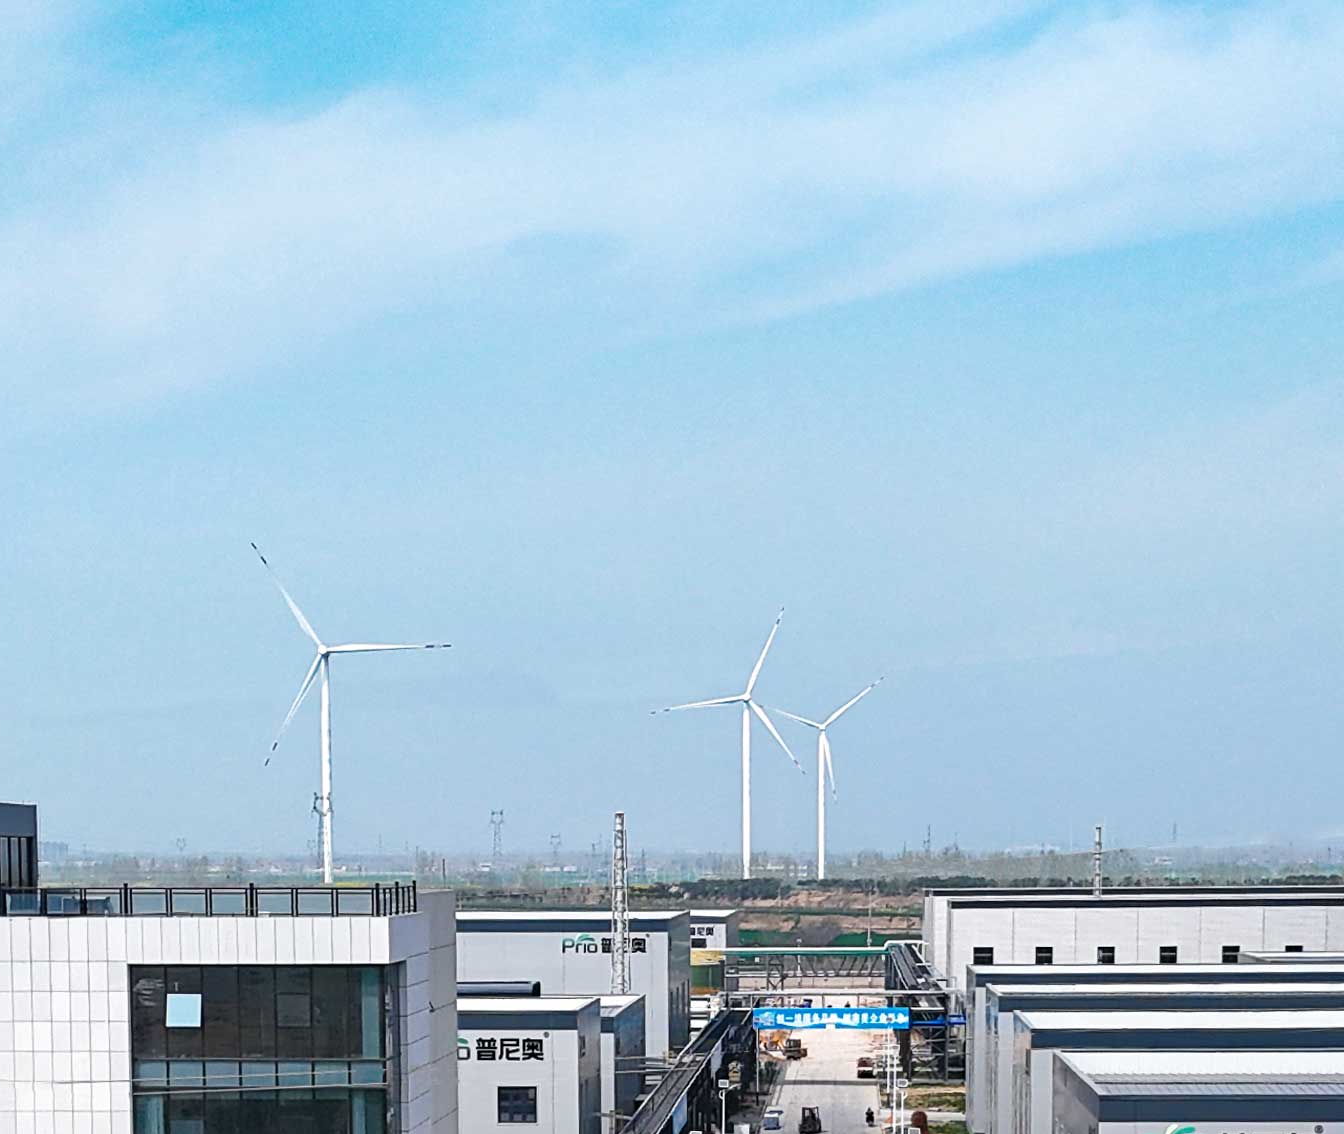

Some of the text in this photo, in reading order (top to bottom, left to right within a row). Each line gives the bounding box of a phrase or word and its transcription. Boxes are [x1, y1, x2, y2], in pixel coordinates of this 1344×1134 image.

[562, 938, 598, 954] Prio
[476, 1037, 544, 1061] 普尼奥
